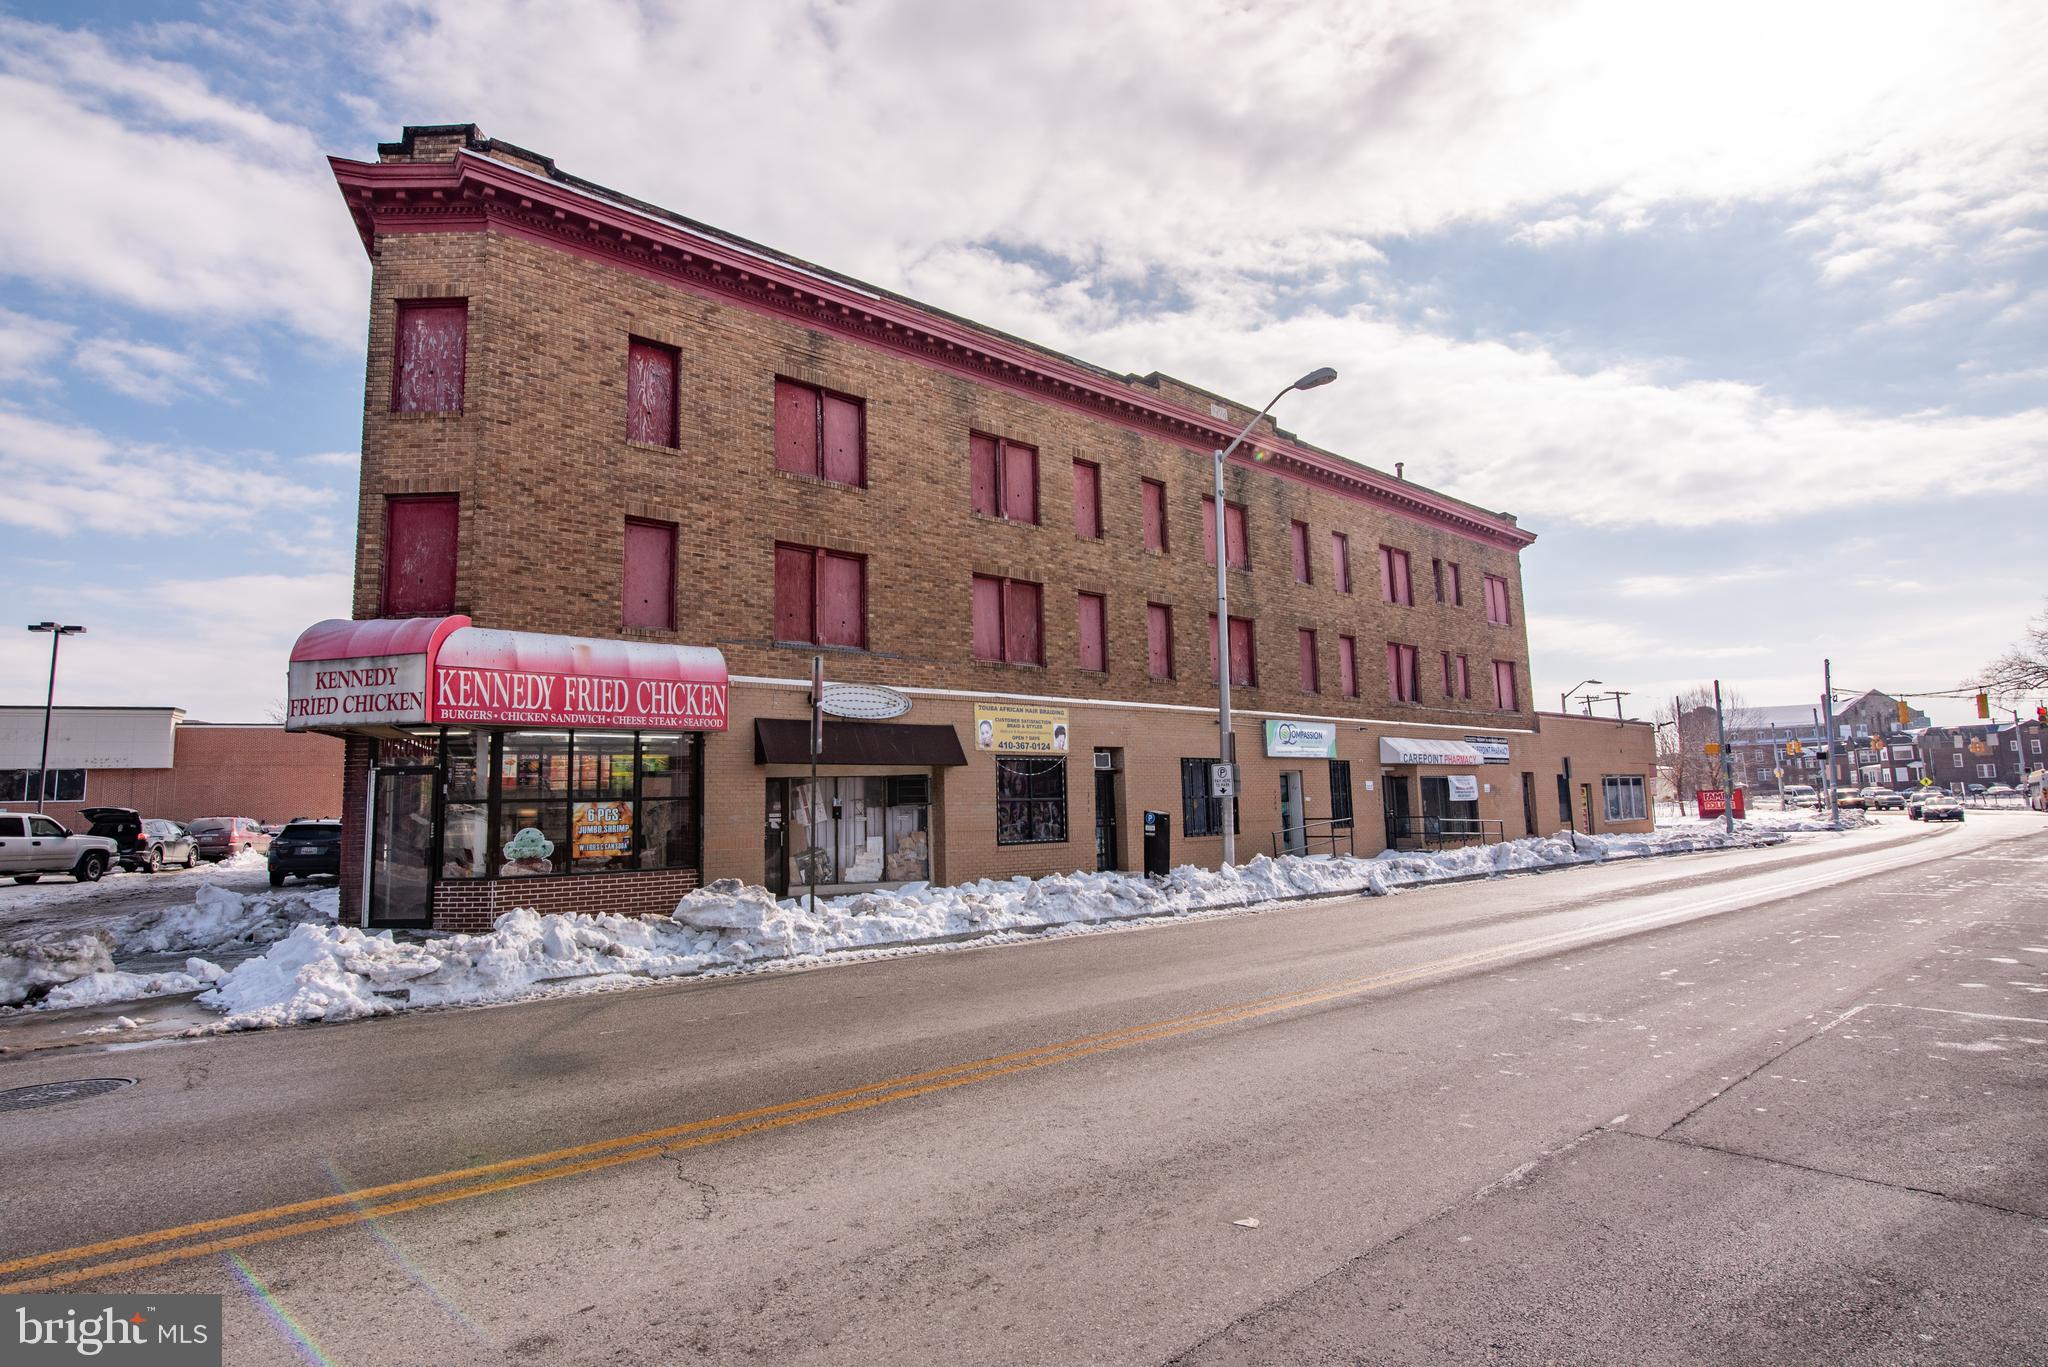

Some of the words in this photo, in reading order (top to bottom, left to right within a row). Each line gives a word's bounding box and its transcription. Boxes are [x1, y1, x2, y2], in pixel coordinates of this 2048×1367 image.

[315, 667, 398, 690] KENNEDY
[437, 669, 556, 710] KENNEDY
[563, 677, 629, 713] FRIED
[636, 681, 726, 716] CHICKEN
[290, 696, 338, 717] FRIED
[342, 691, 424, 713] CHICKEN
[441, 709, 493, 720] BURGERS
[500, 711, 548, 722] CHICKEN
[550, 713, 606, 724] SANDWICH
[612, 715, 647, 725] CHEESE
[648, 717, 678, 726] STEAK
[683, 718, 724, 728] SEAFOOD
[998, 741, 1051, 750] 410-367-0124
[1403, 753, 1444, 764] CAREPOINT
[1444, 754, 1477, 764] PHARMACY
[587, 808, 595, 822] 6
[597, 808, 622, 821] PCS.
[578, 825, 602, 834] JUMBO
[603, 824, 630, 833] SHRIMP
